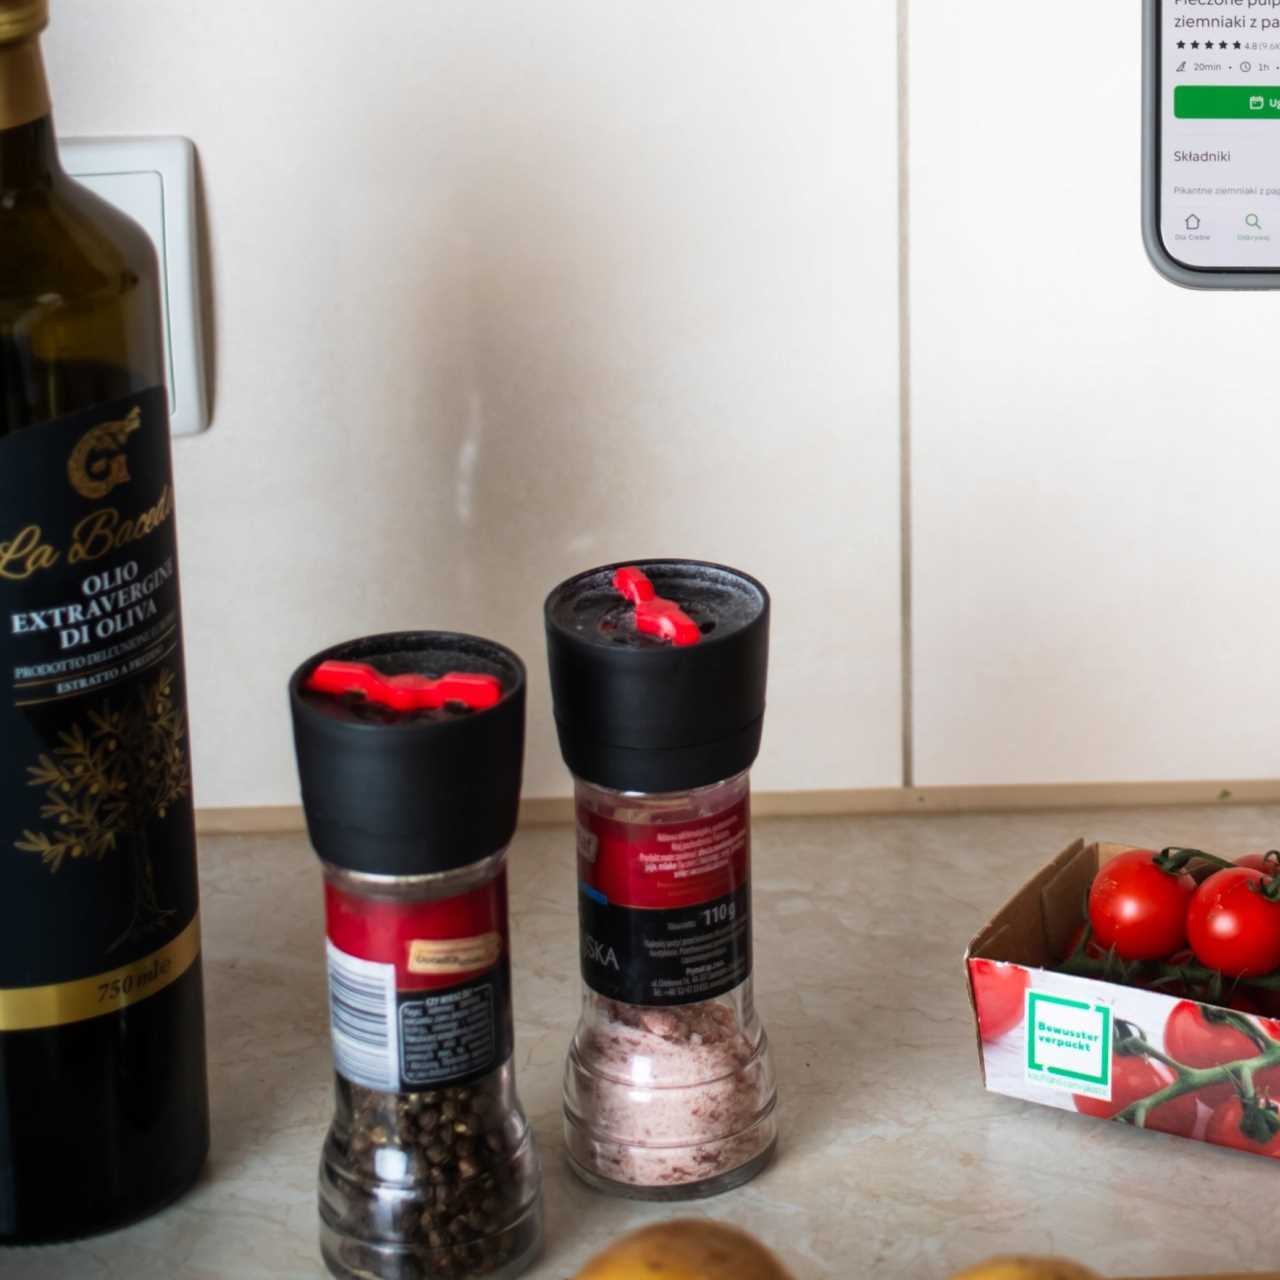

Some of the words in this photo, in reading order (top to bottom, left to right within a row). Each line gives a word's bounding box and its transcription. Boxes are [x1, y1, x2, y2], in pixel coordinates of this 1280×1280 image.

[1174, 15, 1246, 29] ziemniaki
[1249, 19, 1257, 29] z
[1193, 62, 1222, 72] 20min
[1258, 62, 1270, 72] 1h
[1173, 150, 1231, 162] Składniki
[81, 561, 139, 597] OLIO
[60, 624, 91, 650] DI
[95, 598, 158, 638] OLIVA
[56, 665, 120, 694] ESTRATTO
[703, 903, 728, 926] 110
[728, 902, 736, 920] g
[97, 975, 133, 1004] 750
[1038, 1021, 1099, 1042] Bewusster
[1038, 1035, 1091, 1052] verpackt
